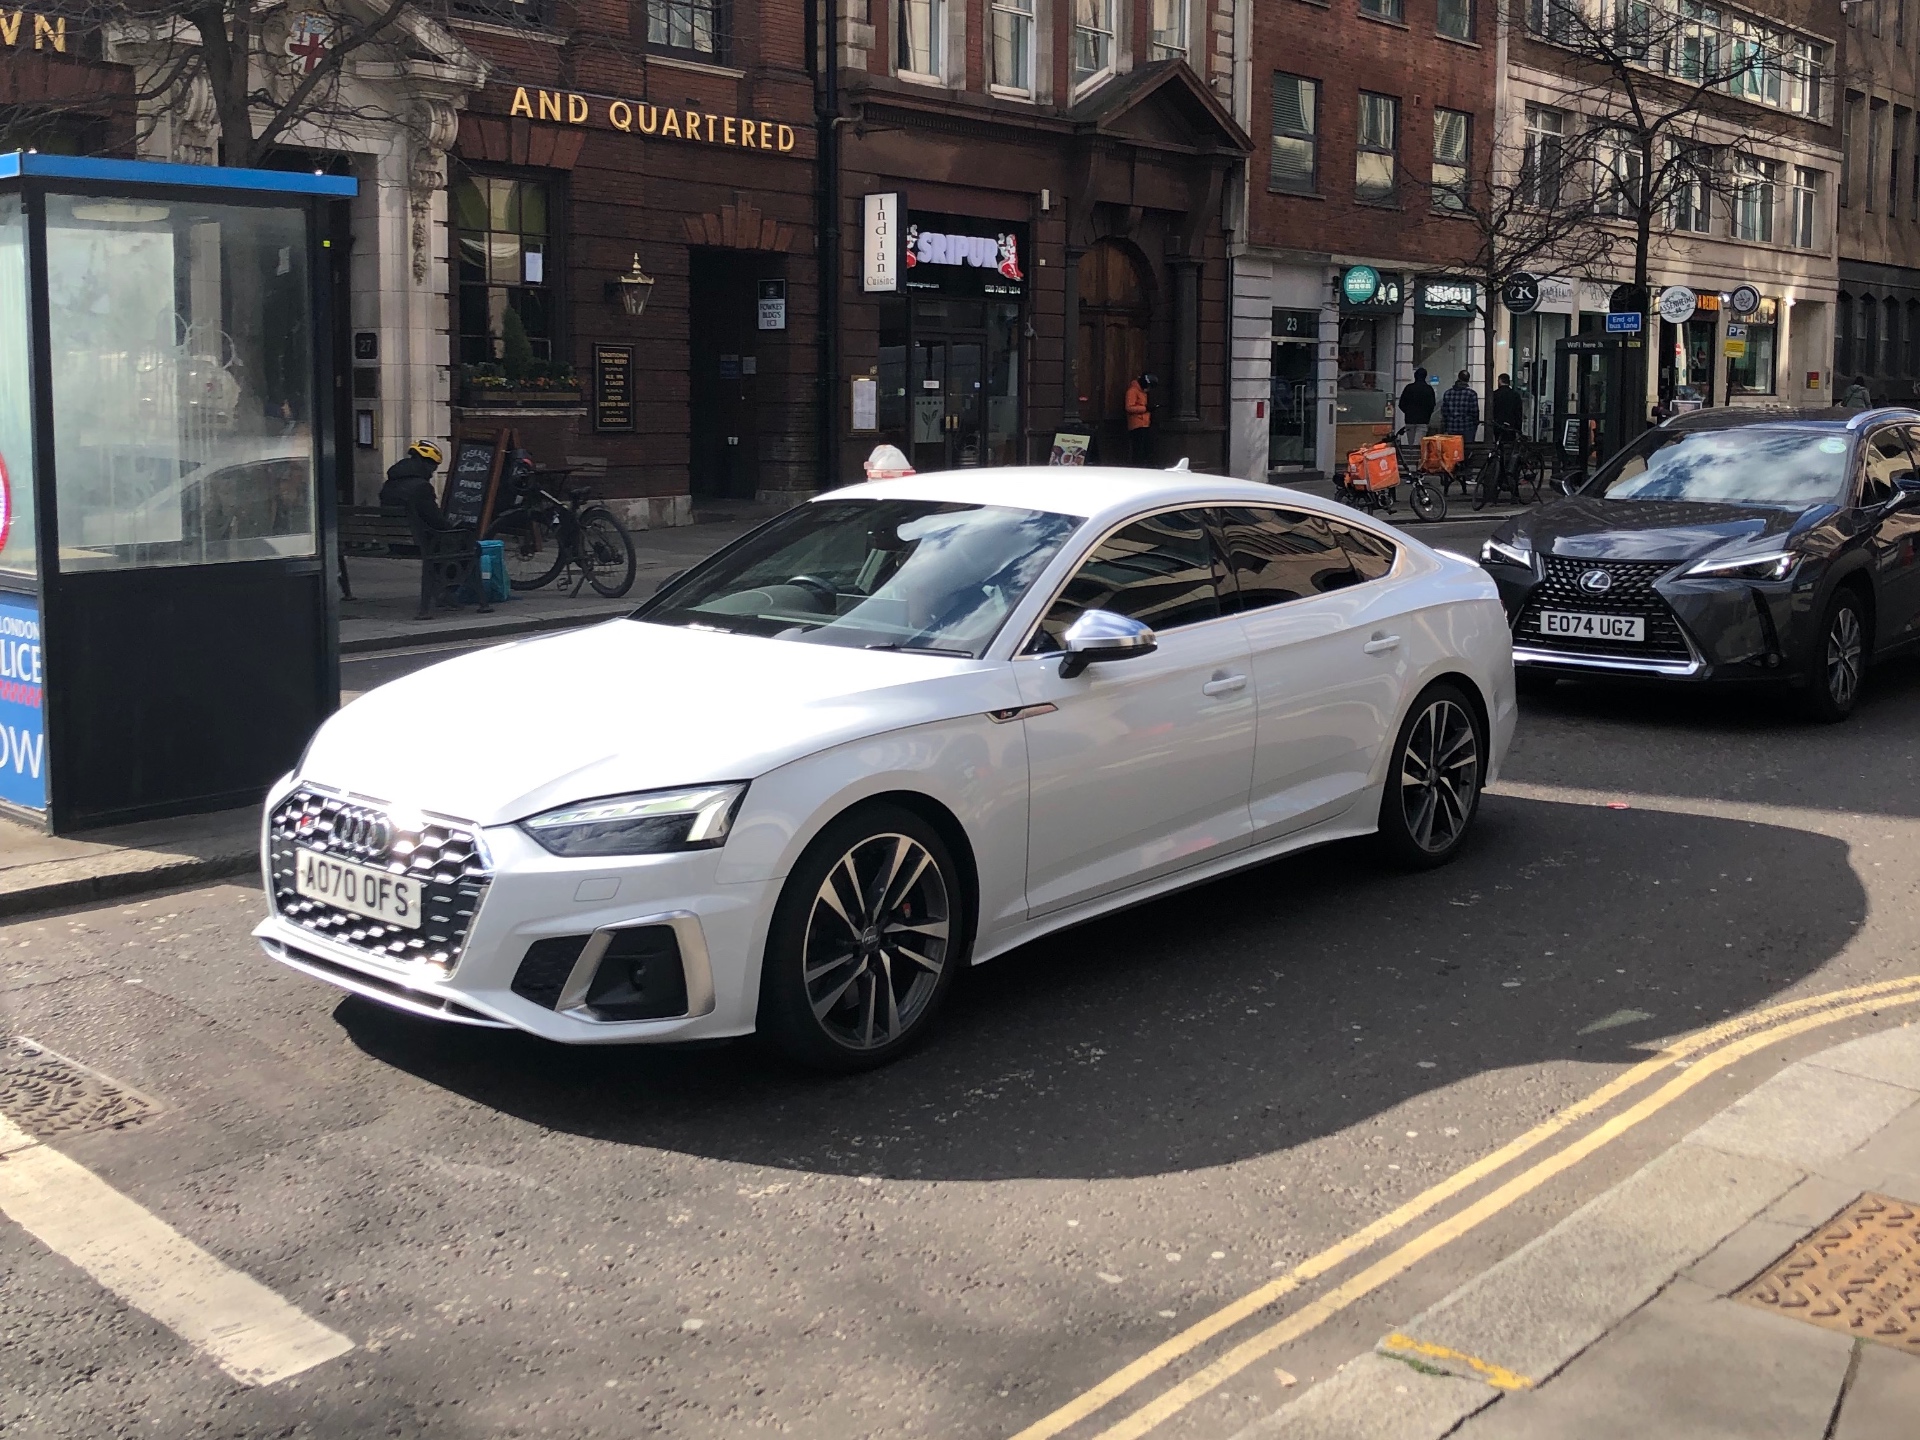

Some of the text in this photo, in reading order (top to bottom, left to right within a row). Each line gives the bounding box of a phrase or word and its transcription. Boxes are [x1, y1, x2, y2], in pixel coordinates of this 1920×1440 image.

[510, 86, 795, 153] AND QUARTERED
[876, 198, 887, 272] Indian
[917, 231, 998, 269] SRIPUR
[866, 275, 895, 286] Cuisine
[1287, 318, 1297, 331] 23
[0, 615, 39, 641] LONDON
[1600, 618, 1635, 638] UGZ
